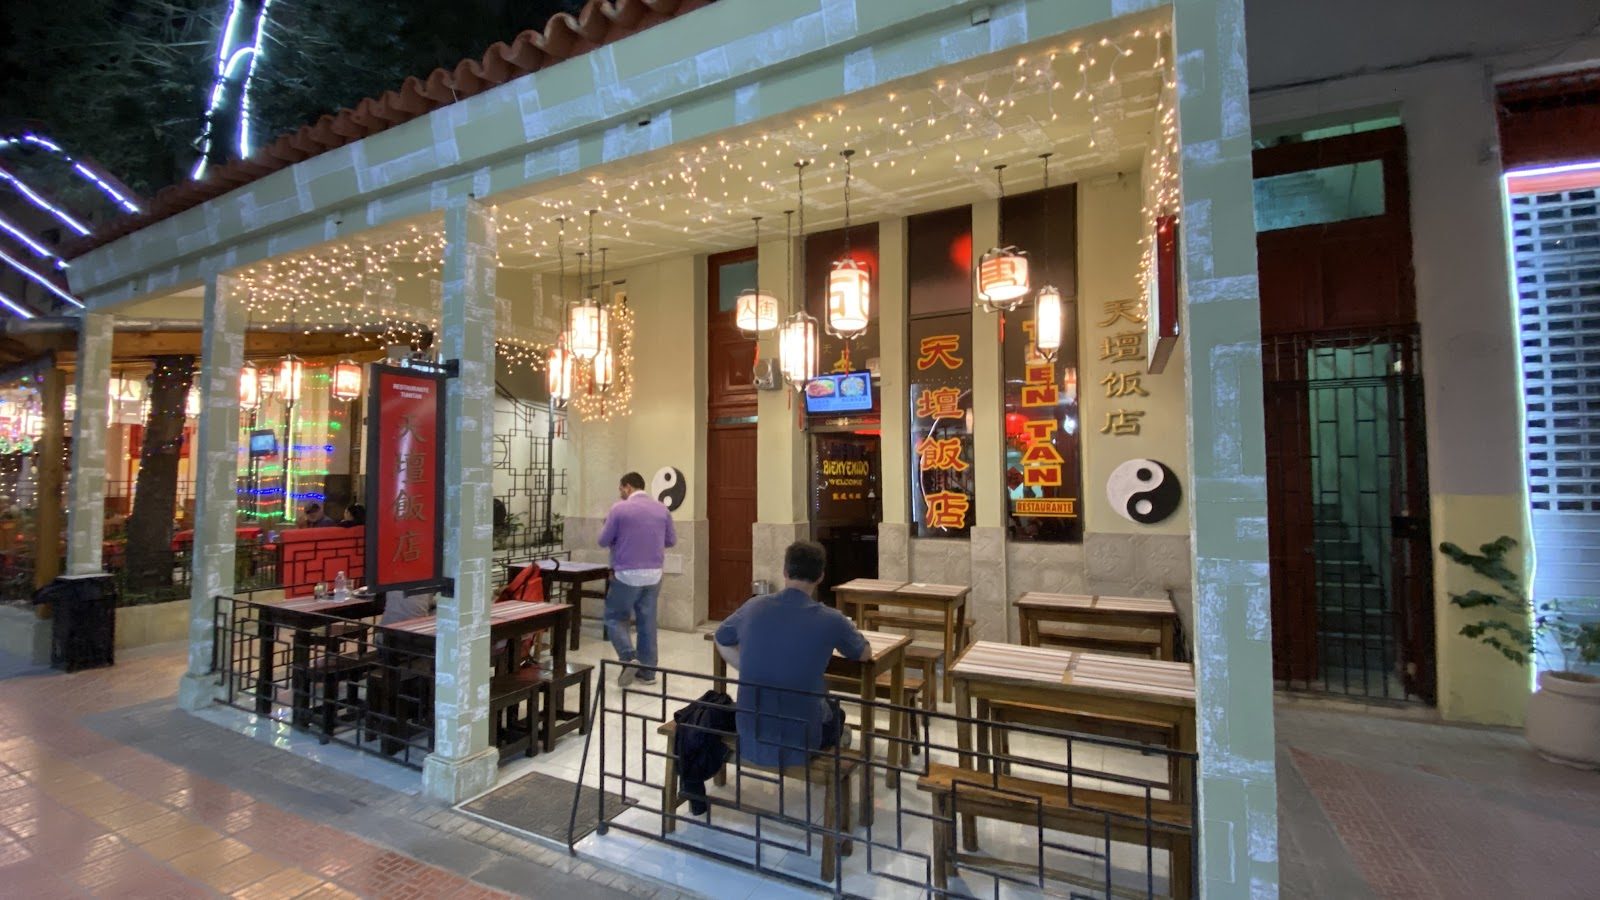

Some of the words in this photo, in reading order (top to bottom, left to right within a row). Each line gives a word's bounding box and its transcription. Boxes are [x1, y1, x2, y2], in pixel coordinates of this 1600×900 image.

[917, 334, 969, 529] 天壇飯店
[1020, 419, 1065, 487] TAN
[1016, 500, 1074, 514] RESTAURANTE
